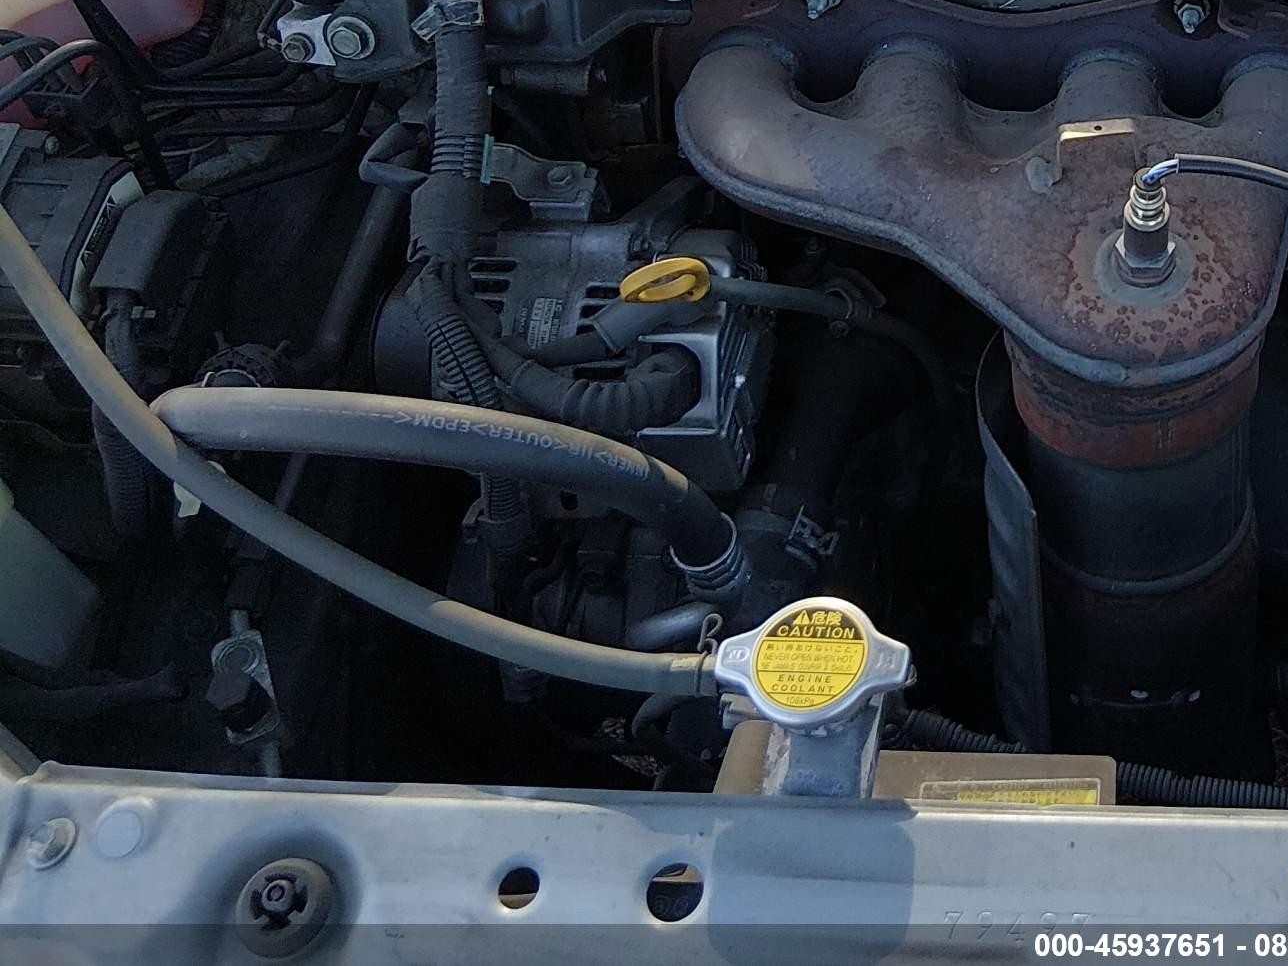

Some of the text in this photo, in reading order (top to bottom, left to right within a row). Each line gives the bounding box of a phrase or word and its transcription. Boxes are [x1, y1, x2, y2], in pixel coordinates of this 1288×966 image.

[811, 611, 843, 626] 危険
[776, 625, 855, 639] CAUTION
[777, 673, 833, 684] ENGINE
[771, 683, 835, 693] COOLANT
